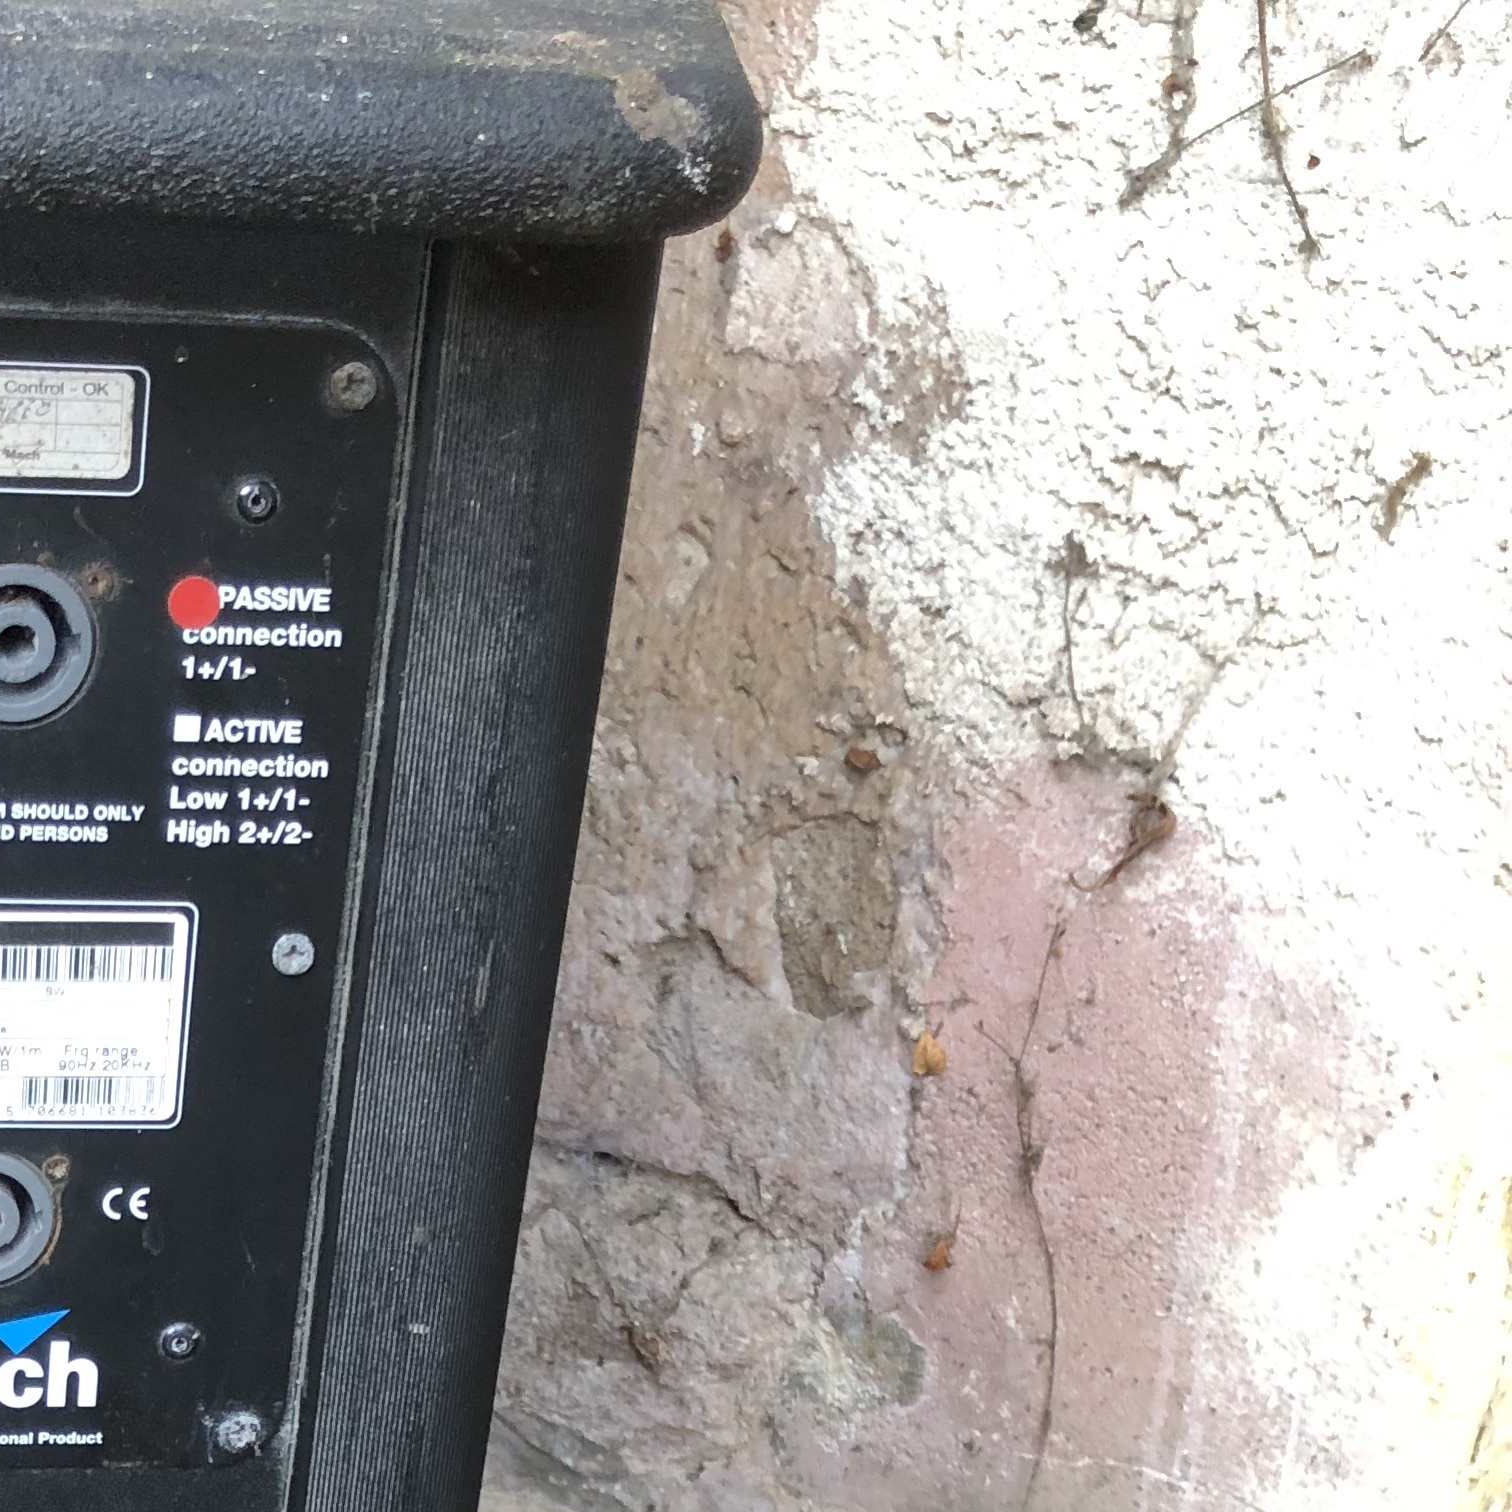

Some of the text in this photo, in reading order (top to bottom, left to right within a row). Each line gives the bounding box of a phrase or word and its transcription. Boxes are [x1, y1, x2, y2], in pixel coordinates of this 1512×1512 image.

[3, 379, 65, 396] Control
[82, 382, 109, 396] OK
[218, 585, 332, 613] PASSIVE
[182, 623, 343, 648] connection
[181, 655, 256, 681] 1+/1-
[204, 717, 303, 744] ACTIVE
[171, 754, 329, 779] connection
[169, 785, 311, 811] Low 1+/1-
[11, 803, 89, 821] SHOULD
[93, 804, 145, 822] ONLY
[19, 824, 109, 842] PERSONS
[166, 819, 313, 848] High 2+/2-
[95, 1047, 138, 1061] range
[38, 1431, 104, 1446] Product
